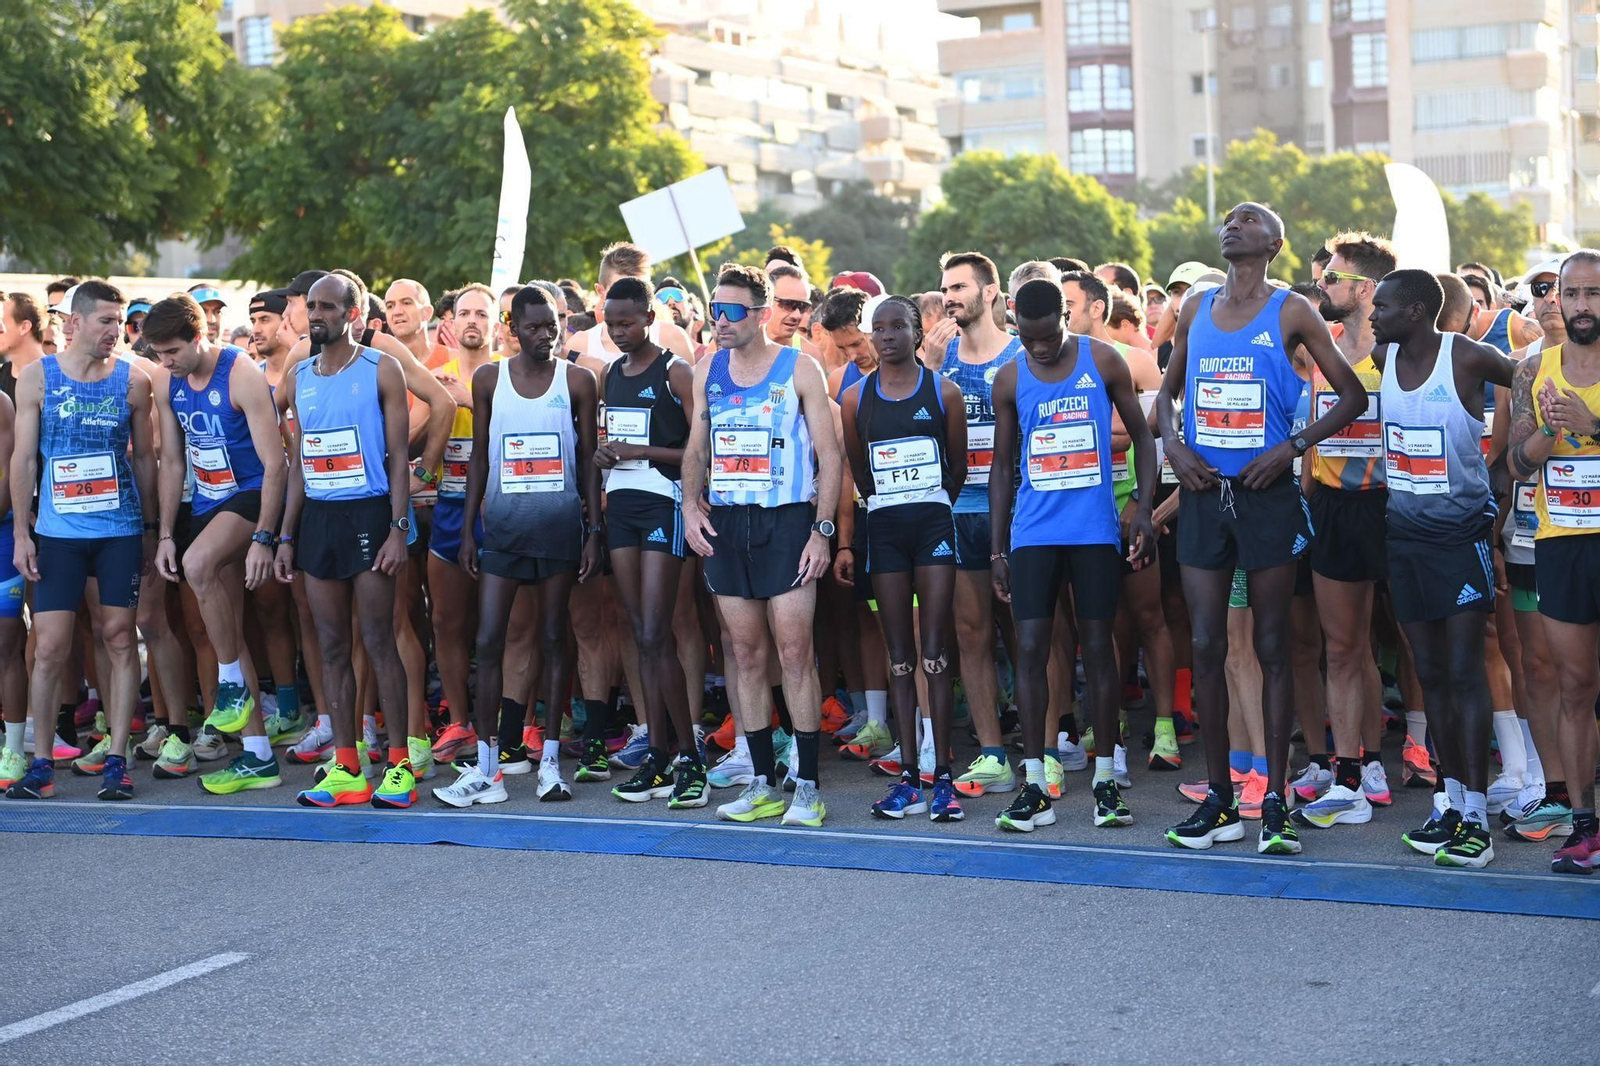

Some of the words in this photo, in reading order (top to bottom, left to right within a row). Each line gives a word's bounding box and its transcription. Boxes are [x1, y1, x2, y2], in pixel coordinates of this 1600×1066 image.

[1251, 338, 1274, 348] adidas
[1200, 357, 1254, 373] RUNCZECH
[1038, 396, 1088, 418] RUNCZECH
[81, 417, 118, 427] Atletismo
[1062, 411, 1087, 420] RACING
[1221, 413, 1230, 426] 4
[326, 458, 334, 470] 6
[526, 462, 534, 473] 3
[1059, 456, 1068, 469] 2
[892, 468, 920, 483] F12
[76, 482, 92, 495] 26
[1572, 491, 1591, 505] 30
[1292, 539, 1308, 554] adidas
[1457, 593, 1482, 605] adidas
